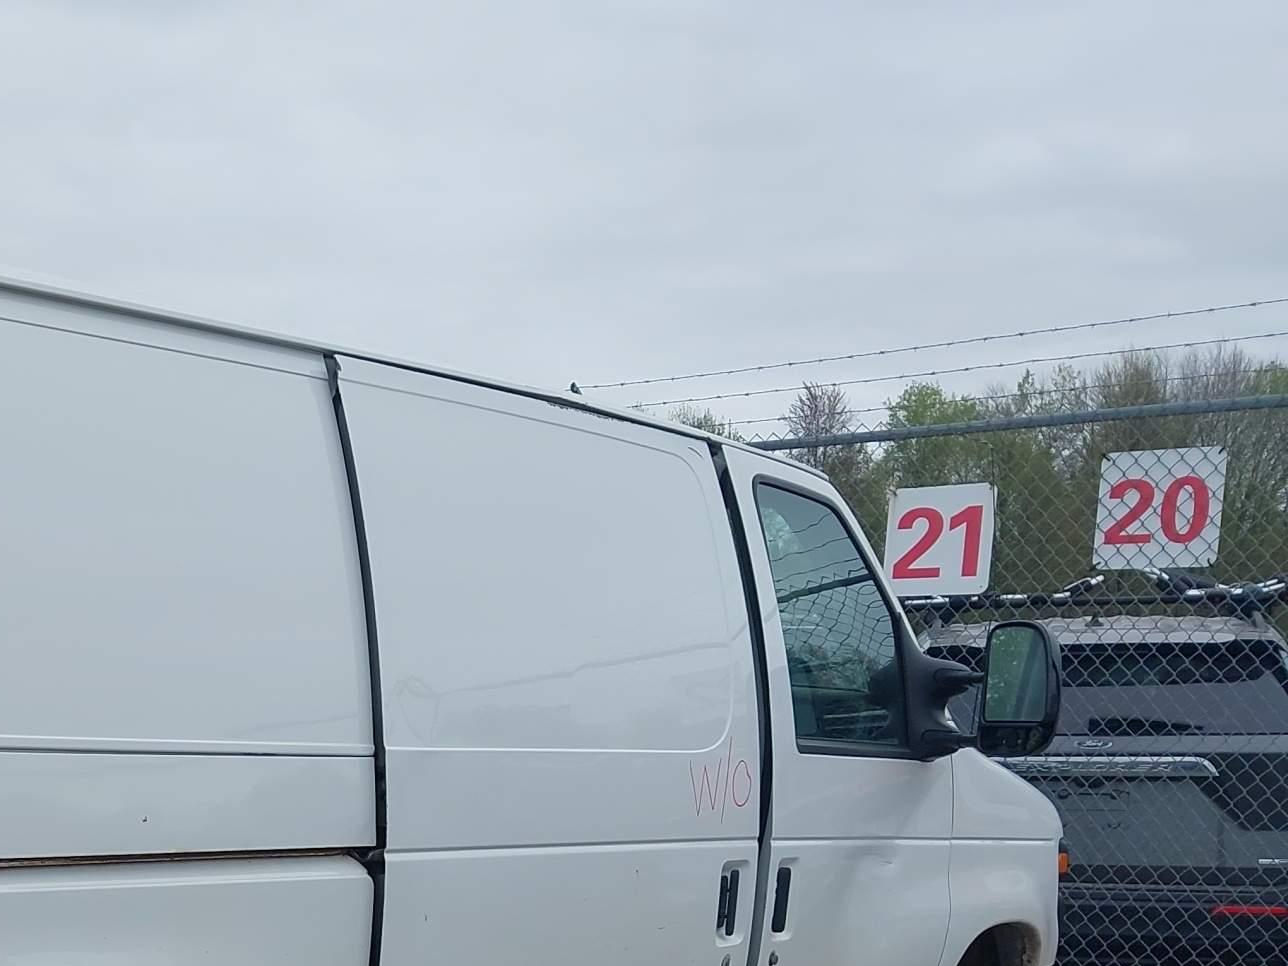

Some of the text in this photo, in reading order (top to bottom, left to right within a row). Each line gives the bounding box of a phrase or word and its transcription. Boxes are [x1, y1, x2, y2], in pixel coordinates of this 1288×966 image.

[892, 504, 984, 580] 21
[1103, 475, 1210, 545] 20
[688, 735, 752, 824] W/O
